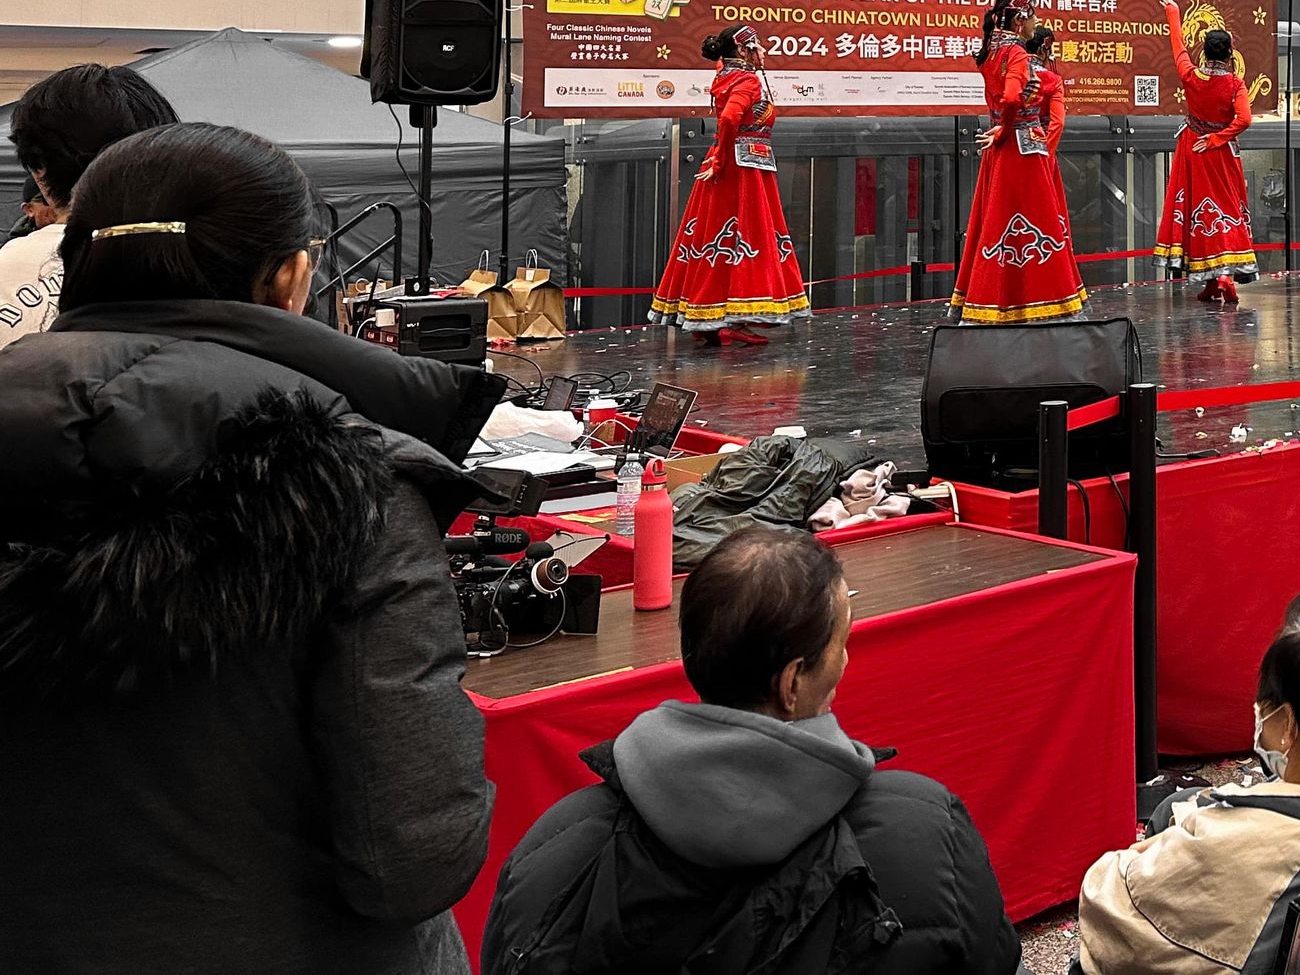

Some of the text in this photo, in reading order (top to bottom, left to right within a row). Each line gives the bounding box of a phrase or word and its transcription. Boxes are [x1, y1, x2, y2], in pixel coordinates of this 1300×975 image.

[711, 5, 806, 23] TORONTO
[811, 9, 920, 27] CHINATOWN
[926, 13, 979, 29] LUNAR
[1067, 19, 1171, 36] CELEBRATIONS
[546, 23, 652, 33] Four Classic Chinese Novels
[550, 32, 572, 40] Mural
[593, 33, 622, 42] Naming
[623, 34, 652, 42] Contest
[767, 35, 829, 56] 2024
[617, 90, 644, 98] CANADA
[495, 533, 522, 544] RØDE
